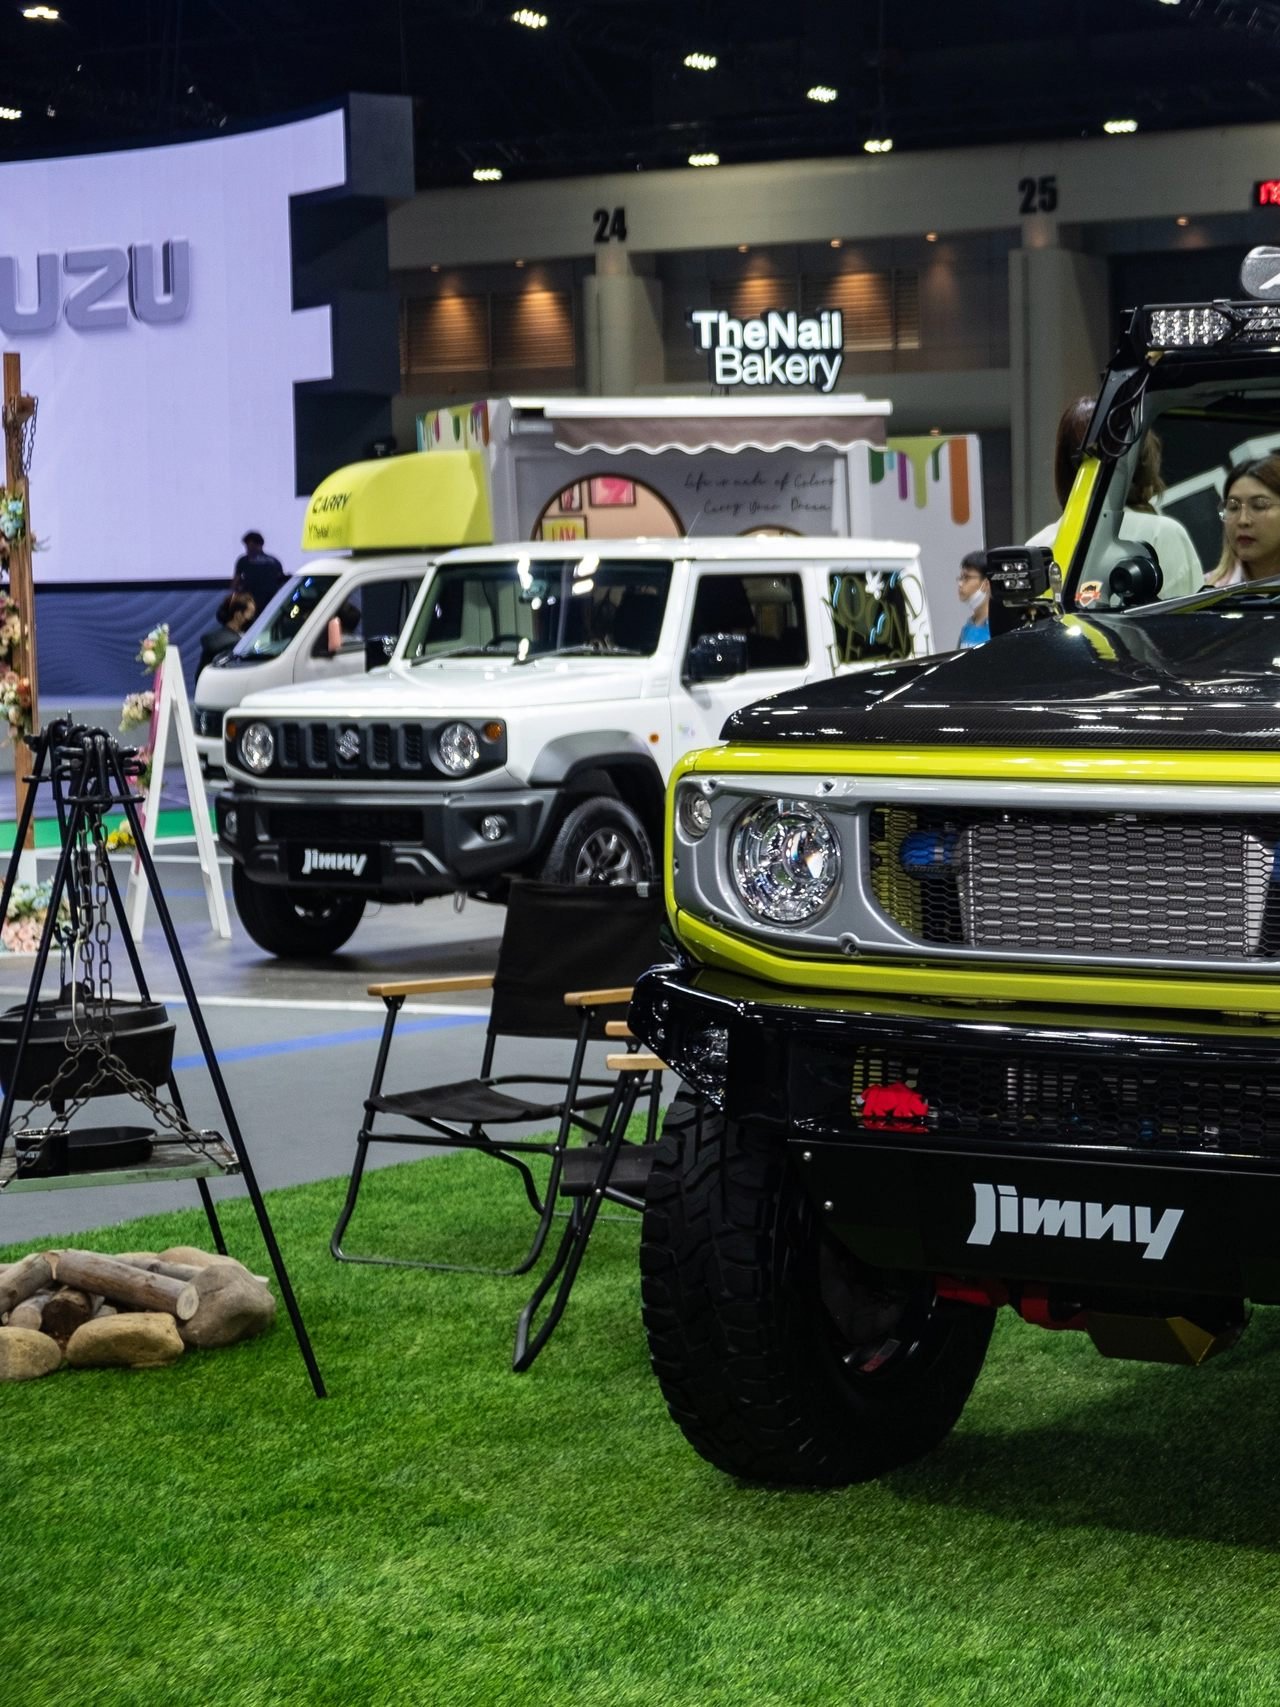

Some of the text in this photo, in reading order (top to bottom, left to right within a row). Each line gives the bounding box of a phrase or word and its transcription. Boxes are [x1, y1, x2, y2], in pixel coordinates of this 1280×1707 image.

[1018, 176, 1057, 214] 25
[593, 208, 627, 243] 24
[715, 346, 842, 392] Bakery
[312, 492, 351, 515] CARRY
[301, 848, 368, 876] Jimny
[966, 1182, 1185, 1261] Jimny
